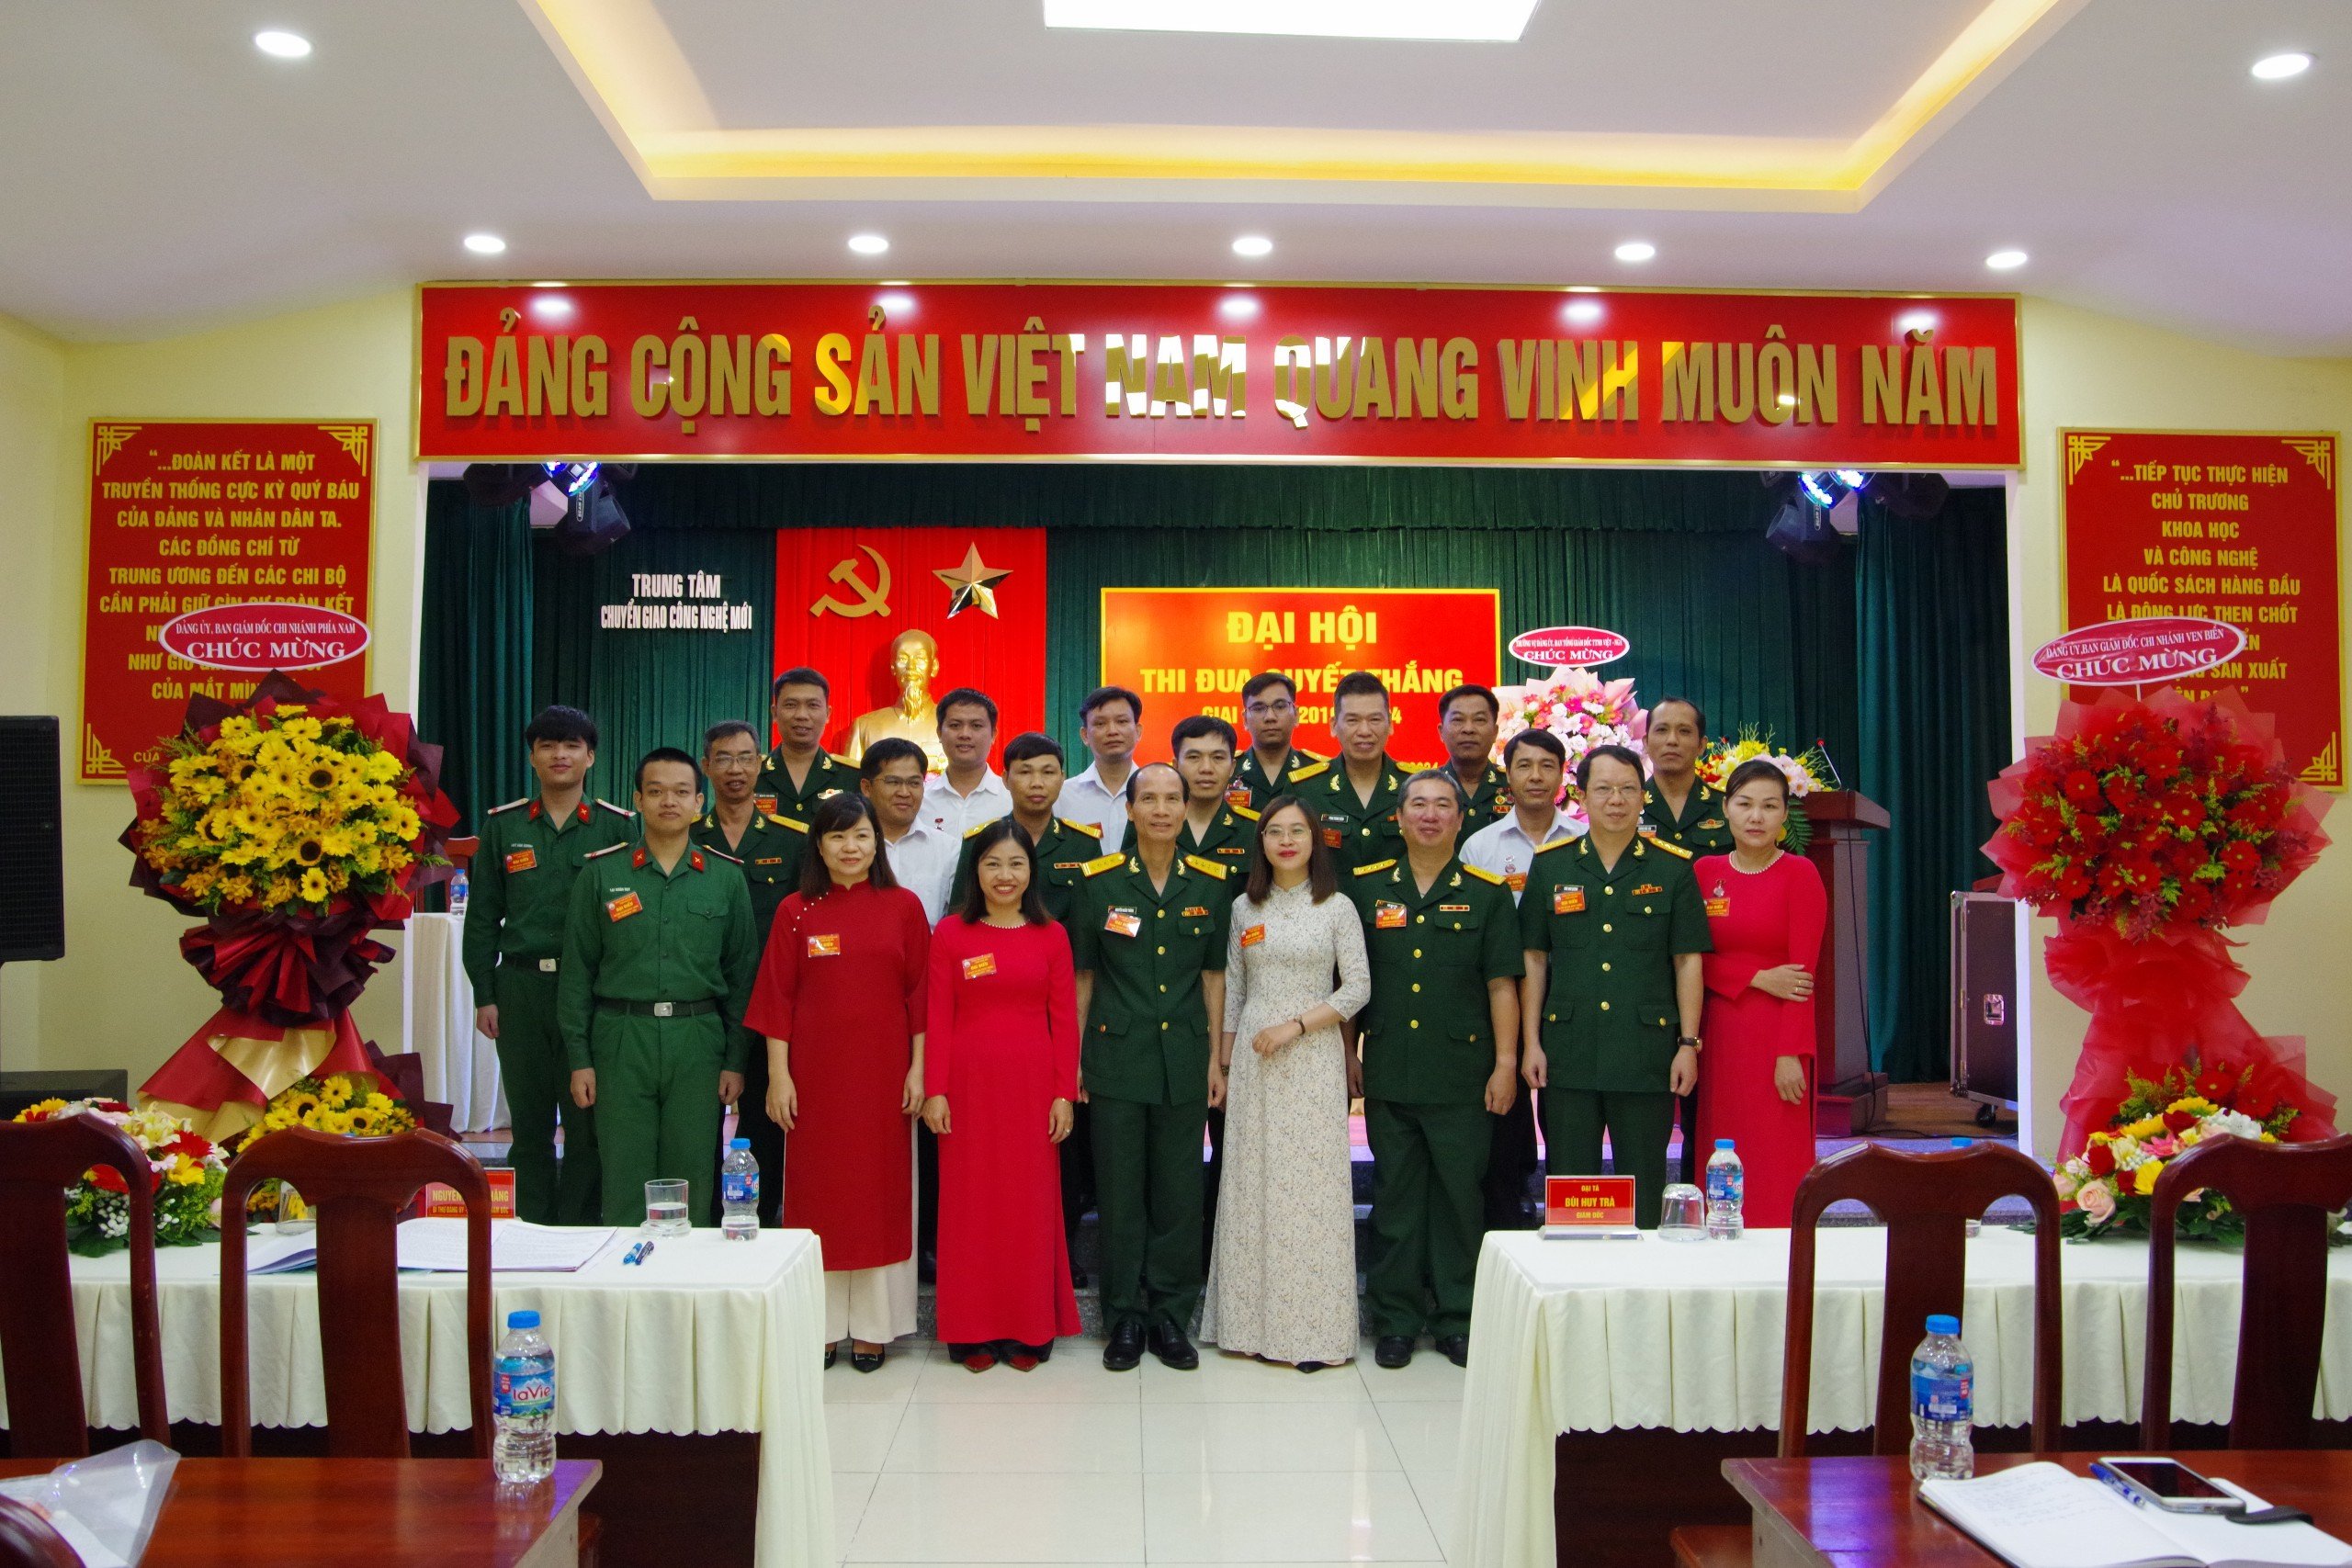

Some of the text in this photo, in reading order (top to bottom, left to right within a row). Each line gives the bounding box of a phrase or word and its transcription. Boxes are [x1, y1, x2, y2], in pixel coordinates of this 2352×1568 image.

[445, 305, 1998, 434] ĐẢNG CỘNG SẢN VIỆT NAM QUANG VINH MUÔN NĂM
[220, 446, 250, 471] KẾT
[255, 451, 276, 471] LÀ
[281, 449, 315, 475] MỘT
[2174, 464, 2201, 487] TỤC
[2207, 465, 2246, 488] THỰC
[2252, 463, 2289, 488] HIỆN
[102, 476, 359, 502] TRUYỀN THỐNG CỰC KỲ QUÝ BÁU
[2152, 487, 2249, 511] CHỦ TRƯƠNG
[117, 505, 343, 528] CỦA ĐẢNG VÀ NHÂN DÂN TA.
[2162, 521, 2240, 542] KHOA HỌC
[159, 534, 300, 557] CÁC ĐỒNG CHÍ TỪ
[2143, 546, 2259, 570] VÀ CÔNG NGHỆ
[109, 562, 346, 589] TRUNG ƯƠNG ĐẾN CÁC CHI BỘ
[631, 569, 721, 598] TRUNG TÂM
[2103, 571, 2301, 596] LÀ QUỐC SÁCH HÀNG ĐẦU
[99, 590, 131, 613] CẦN
[139, 592, 175, 614] PHẢI
[2214, 605, 2253, 622] THEN
[2258, 599, 2297, 624] CHỐT
[215, 623, 233, 634] BAN
[234, 619, 254, 634] GIÁM
[254, 617, 272, 634] ĐỐC
[274, 623, 287, 634] CHI
[288, 620, 317, 634] NHÁNH
[318, 620, 336, 634] PHÍA
[337, 623, 356, 635] NAM
[601, 598, 752, 634] CHUYỂN GIAO CÔNG NGHỆ MỚI
[1227, 604, 1377, 651] ĐẠI HỘI
[187, 636, 345, 659] CHÚC MỪNG
[2100, 637, 2120, 653] GIÁM
[2121, 634, 2139, 650] ĐỐC
[2140, 636, 2154, 649] CHI
[2155, 631, 2185, 648] NHÁNH
[2187, 630, 2203, 643] VEN
[2205, 624, 2224, 640] BIỂN
[129, 652, 163, 671] NHƯ
[1523, 647, 1613, 660] CHÚC MỪNG
[2056, 648, 2218, 680] CHÚC MỪNG
[2247, 657, 2288, 680] XUẤT
[152, 677, 184, 699] CỦA
[189, 678, 224, 700] MẮT
[1140, 669, 1186, 694] THI
[1202, 705, 1238, 725] GIAI
[1581, 1197, 1598, 1207] HUY
